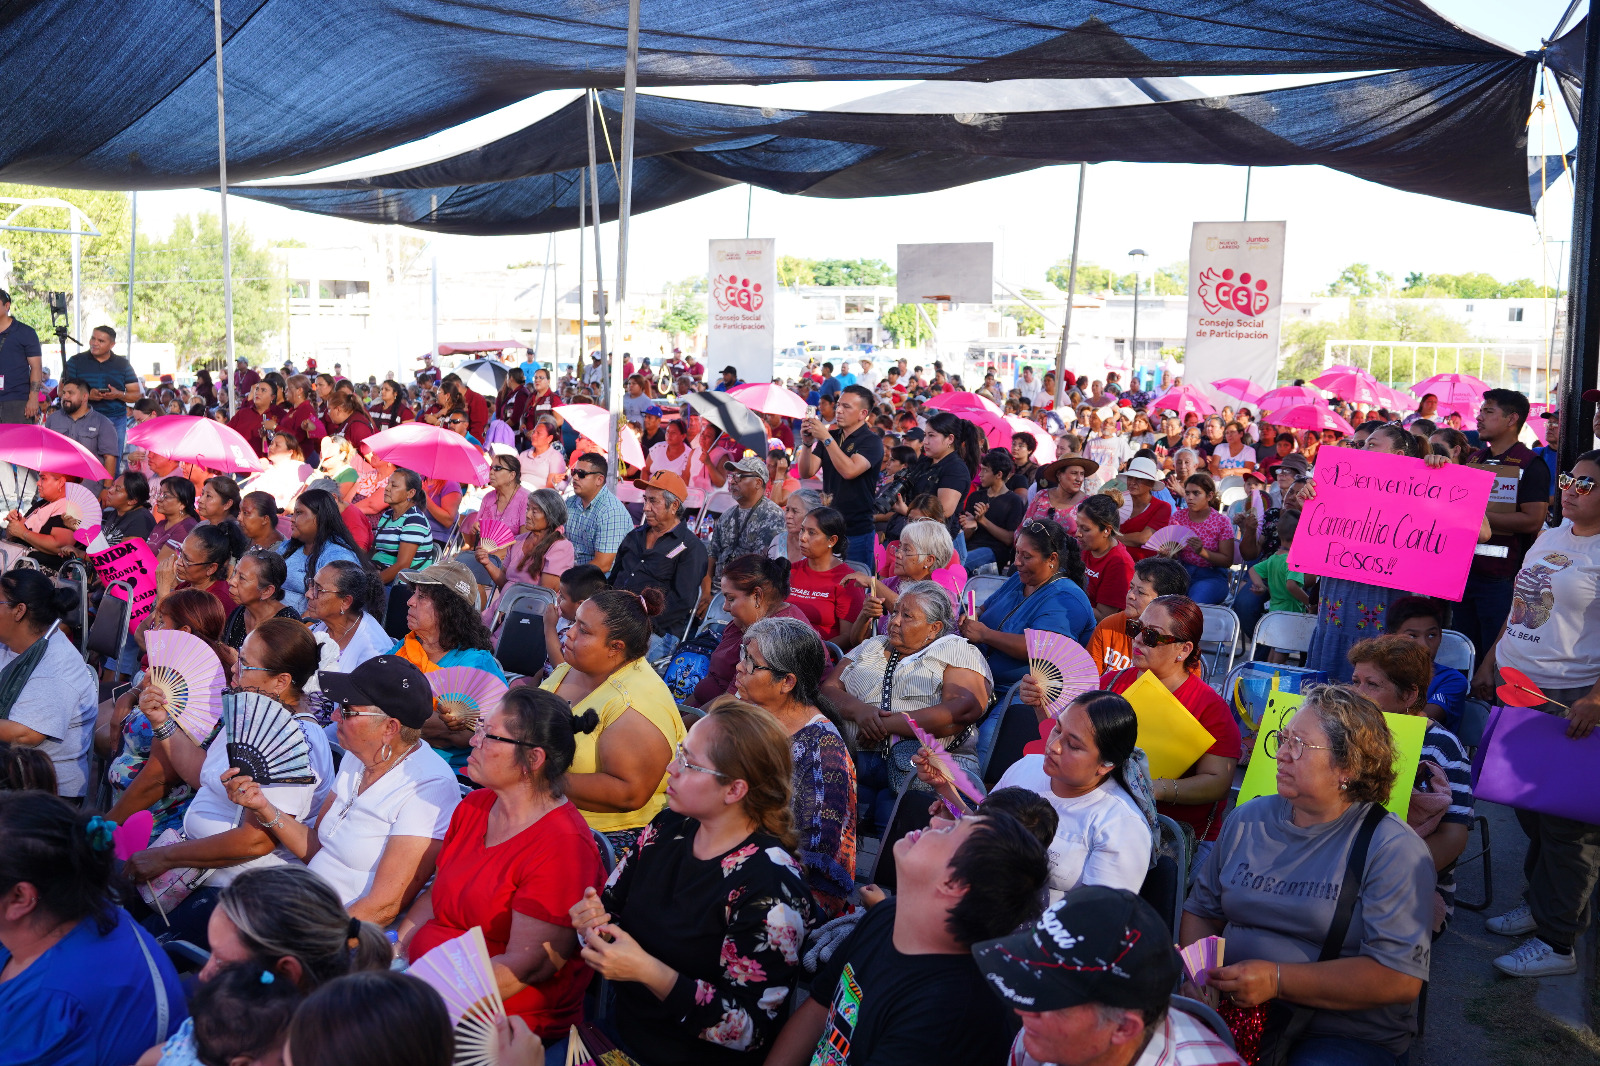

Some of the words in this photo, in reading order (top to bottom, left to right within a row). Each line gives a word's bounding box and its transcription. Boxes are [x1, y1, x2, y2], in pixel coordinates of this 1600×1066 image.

[726, 288, 763, 309] CSP
[1217, 284, 1268, 311] CSP
[1198, 318, 1234, 329] Consejo
[1236, 319, 1264, 328] Social
[1196, 329, 1207, 337] de
[1209, 329, 1269, 340] Participación
[1334, 461, 1442, 499] Bienvenida
[1517, 631, 1541, 643] BEAR
